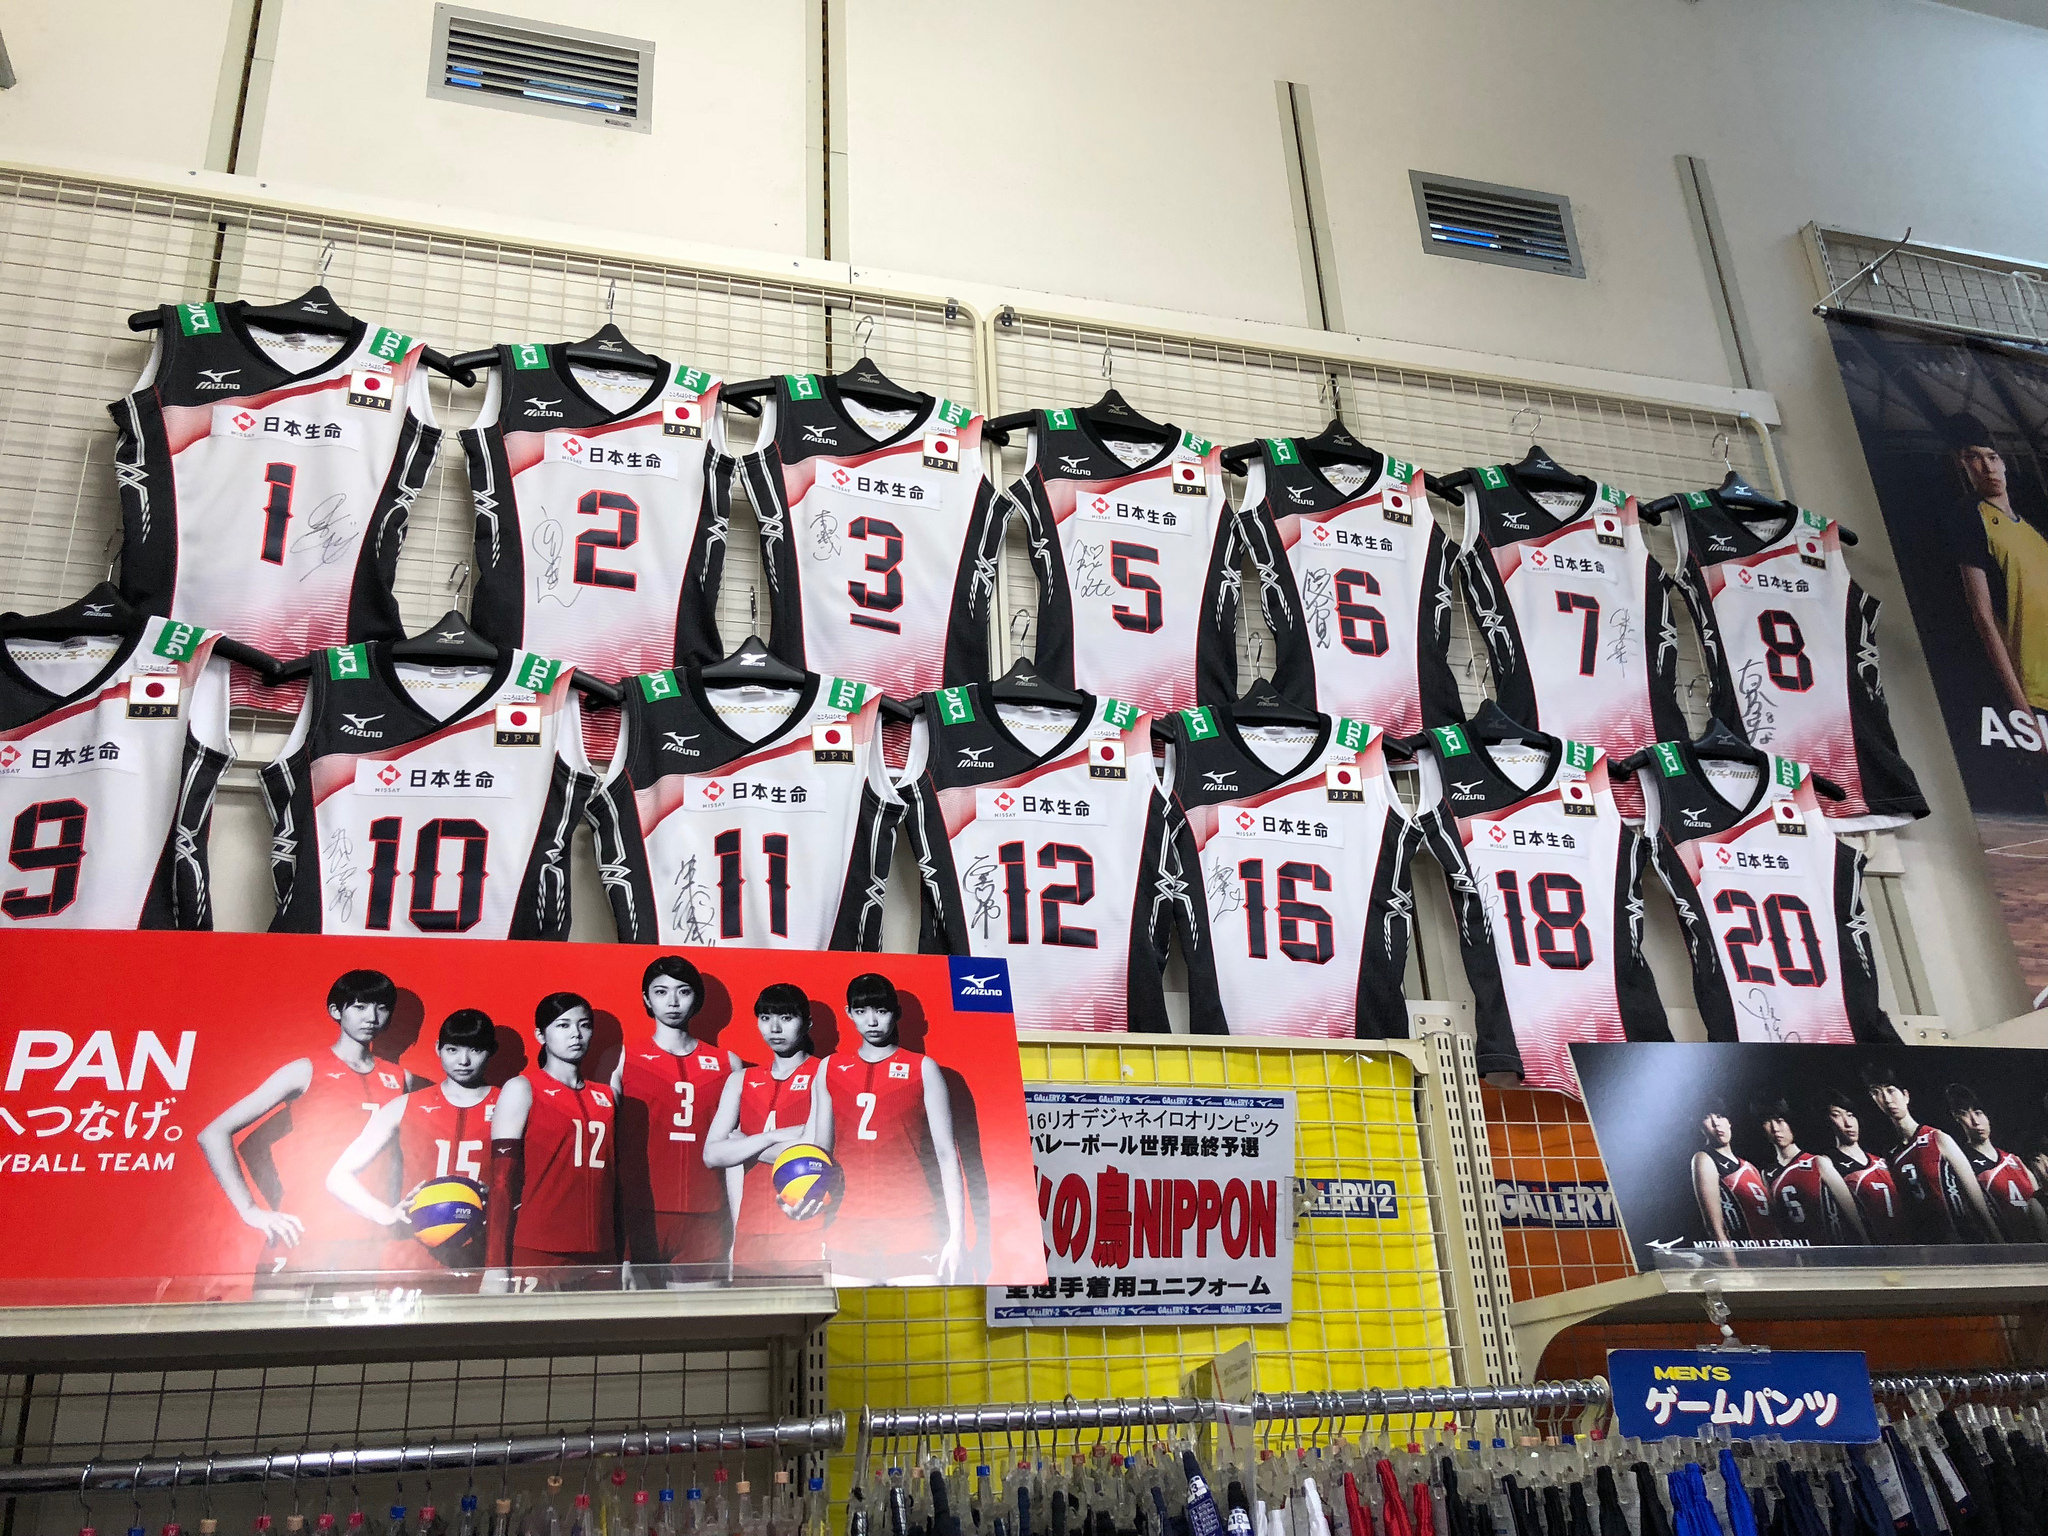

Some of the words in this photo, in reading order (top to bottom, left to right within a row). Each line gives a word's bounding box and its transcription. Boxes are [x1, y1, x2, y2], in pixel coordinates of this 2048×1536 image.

[195, 381, 240, 390] MIZUNO
[354, 397, 385, 408] JPN
[524, 409, 563, 417] MIZUNO
[263, 417, 342, 439] 日本生命
[668, 426, 697, 435] JPN
[802, 433, 837, 446] MIZUNO
[589, 447, 662, 468] 日本生命
[928, 459, 954, 469] JPN
[1060, 465, 1091, 476] MIZUNO
[857, 477, 924, 501] 日本生命
[1177, 485, 1202, 495] JPN
[261, 461, 296, 566] 1
[1116, 503, 1177, 526] 日本生命
[1386, 512, 1409, 523] JPN
[574, 489, 640, 592] 2
[1336, 530, 1393, 552] 日本生命
[847, 516, 904, 613] 3
[1554, 555, 1605, 574] 日本生命
[1110, 540, 1163, 634] 5
[1757, 575, 1810, 592] 日本生命
[1333, 568, 1391, 658] 6
[1555, 590, 1600, 677] 7
[1757, 609, 1814, 693] 8
[135, 706, 172, 715] JPN
[340, 724, 383, 738] MIZUNO
[502, 733, 535, 743] JPN
[32, 741, 121, 769] 日本生命
[661, 742, 700, 757] MIZUNO
[820, 753, 849, 761] JPN
[957, 759, 994, 768] MIZUNO
[1093, 768, 1121, 777] JPN
[410, 769, 495, 789] 日本生命
[1202, 783, 1238, 791] MIZUNO
[732, 782, 808, 804] 日本生命
[1332, 791, 1359, 800] JPN
[1451, 793, 1485, 801] MIZUNO
[1023, 796, 1090, 817] 日本生命
[1568, 805, 1592, 814] JPN
[1263, 816, 1328, 839] 日本生命
[1513, 830, 1576, 849] 日本生命
[0, 797, 87, 921] 9
[1736, 852, 1789, 869] 日本生命
[364, 816, 490, 933] 10
[714, 828, 791, 939] 11
[999, 840, 1099, 950] 12
[1238, 858, 1335, 965] 16
[1495, 870, 1594, 970] 18
[1713, 889, 1827, 988] 20
[960, 987, 1003, 996] MIZUNO
[4, 1030, 197, 1092] PAN
[673, 1081, 695, 1127] 3
[856, 1092, 878, 1140] 2
[1028, 1107, 1280, 1138] 16リオデジャネイロオリンピック
[571, 1119, 606, 1169] 12
[1030, 1133, 1260, 1158] バレーボール世界最終予選
[98, 1152, 175, 1172] TEAM
[435, 1139, 483, 1179] 15
[1496, 1183, 1614, 1220] GALLERY
[1873, 1181, 1895, 1218] 7
[272, 1257, 287, 1276] 7
[1653, 1366, 1732, 1382] MEN'S
[1645, 1386, 1838, 1426] ゲームパンツ
